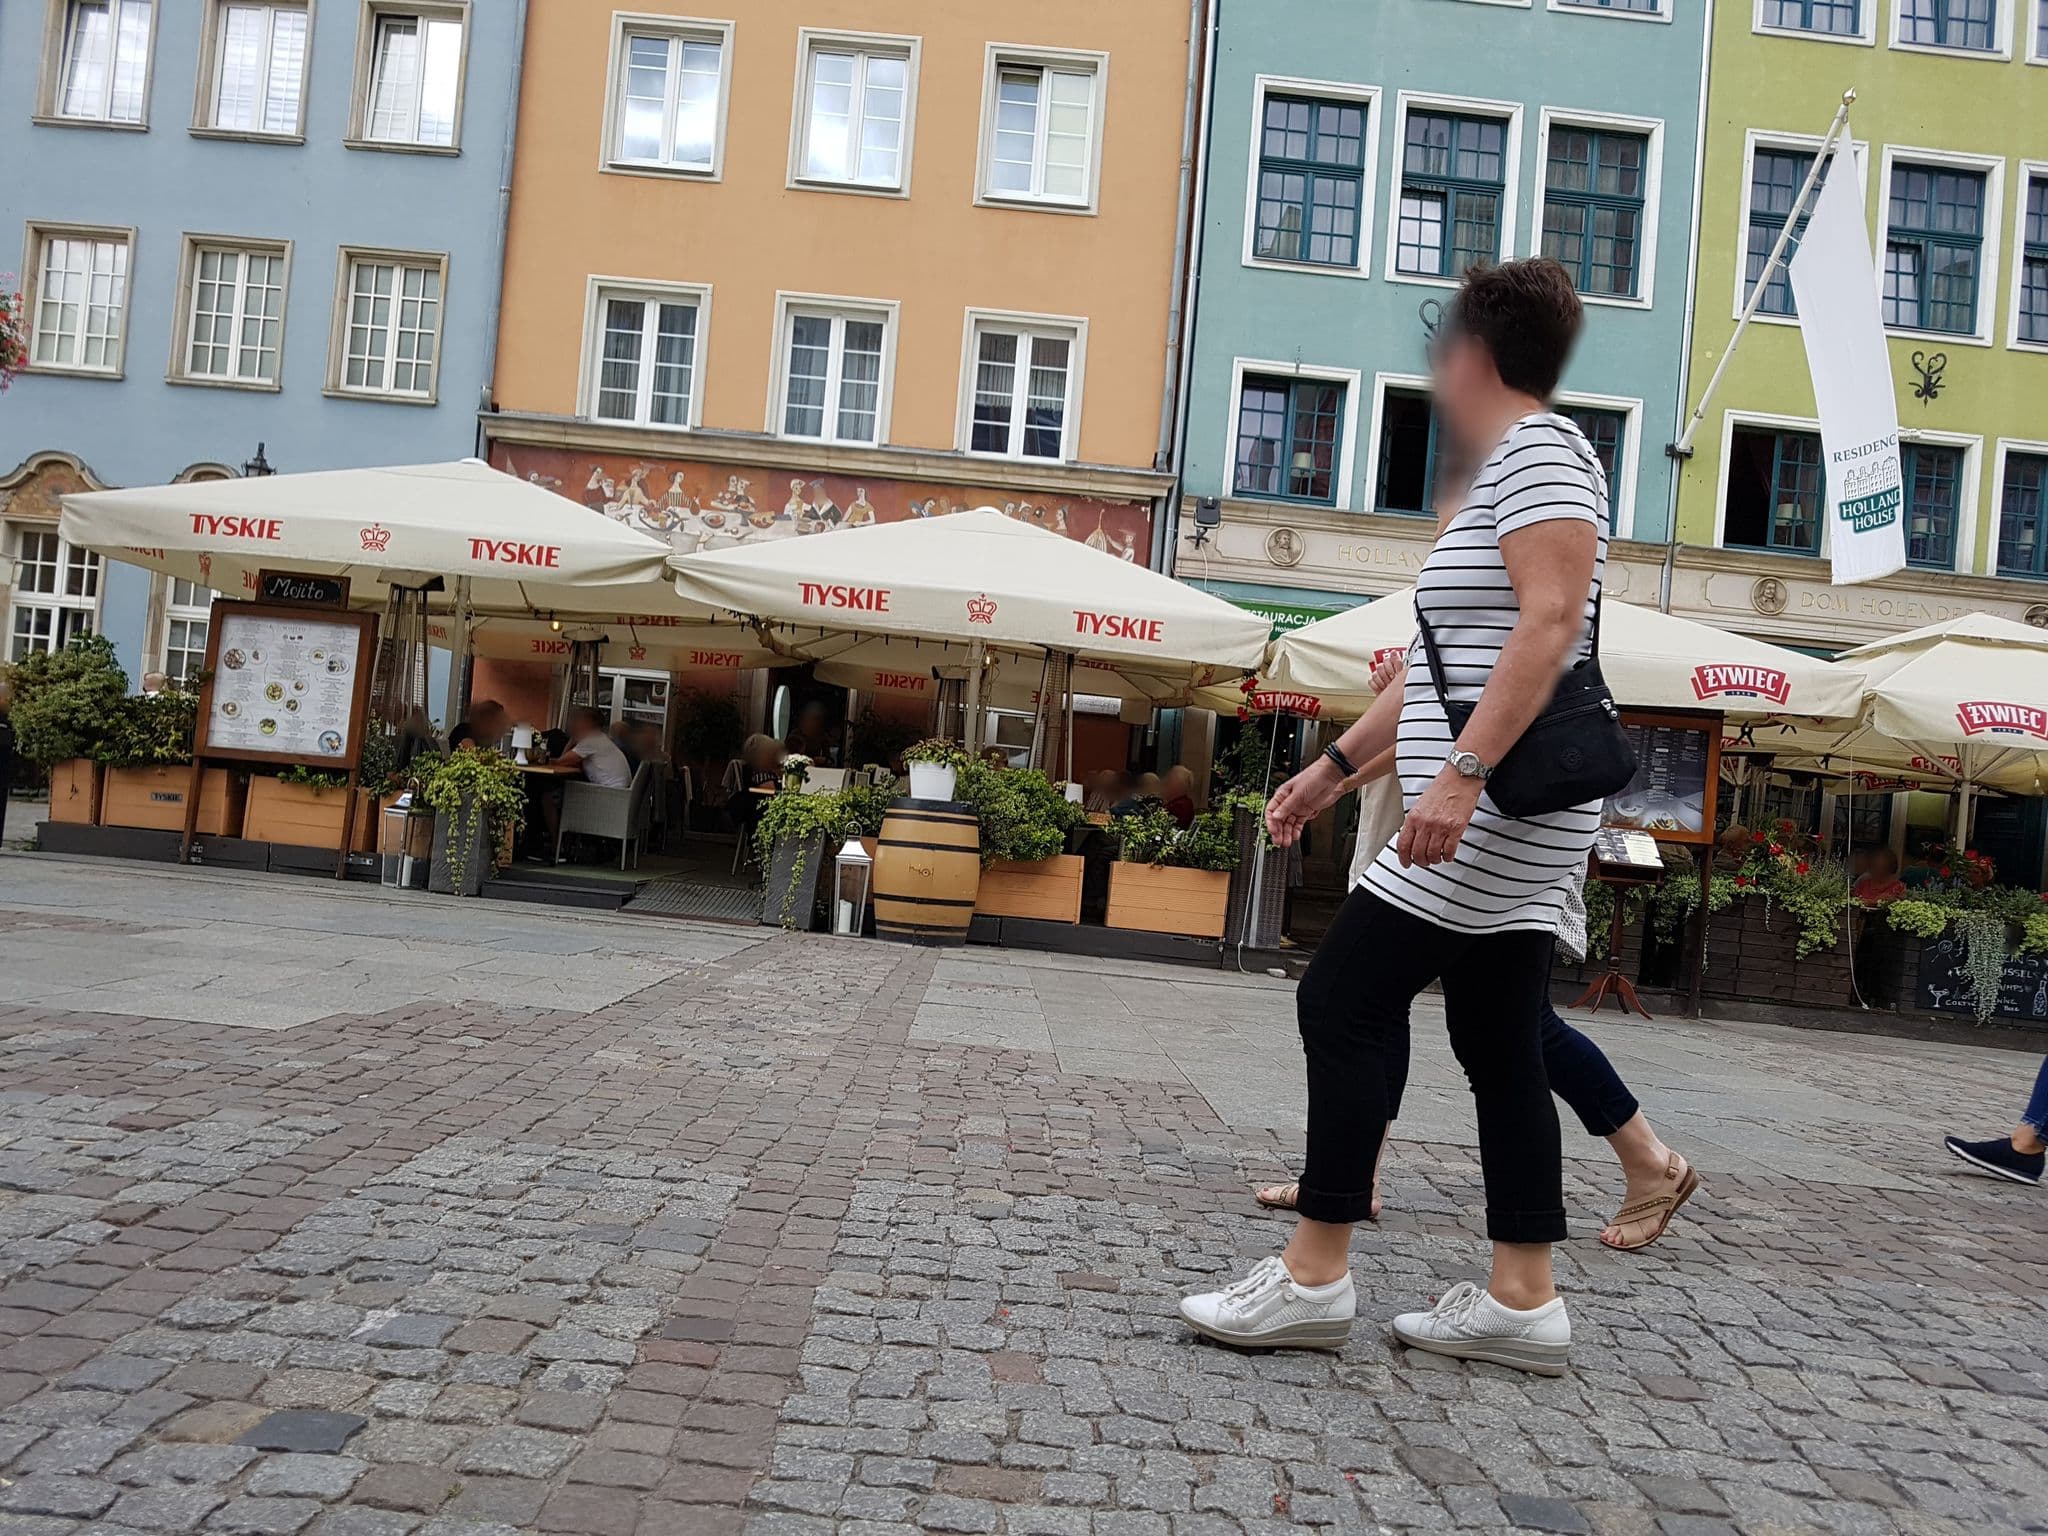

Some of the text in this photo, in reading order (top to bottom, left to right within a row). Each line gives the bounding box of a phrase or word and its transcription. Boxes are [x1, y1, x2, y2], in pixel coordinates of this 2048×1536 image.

[1833, 433, 1897, 462] RESIDENC
[1842, 489, 1900, 518] HOLLAND
[189, 513, 284, 540] TYSKIE
[1855, 507, 1895, 530] HOUSE
[467, 538, 561, 568] TYSKIE
[269, 578, 324, 600] Mojito
[798, 582, 891, 612] TYSKIE
[1800, 591, 1849, 613] DOM
[1072, 610, 1164, 642] TYSKIE
[1702, 665, 1779, 692] ŻYWIEC
[1966, 703, 2041, 729] ŻYWIEC
